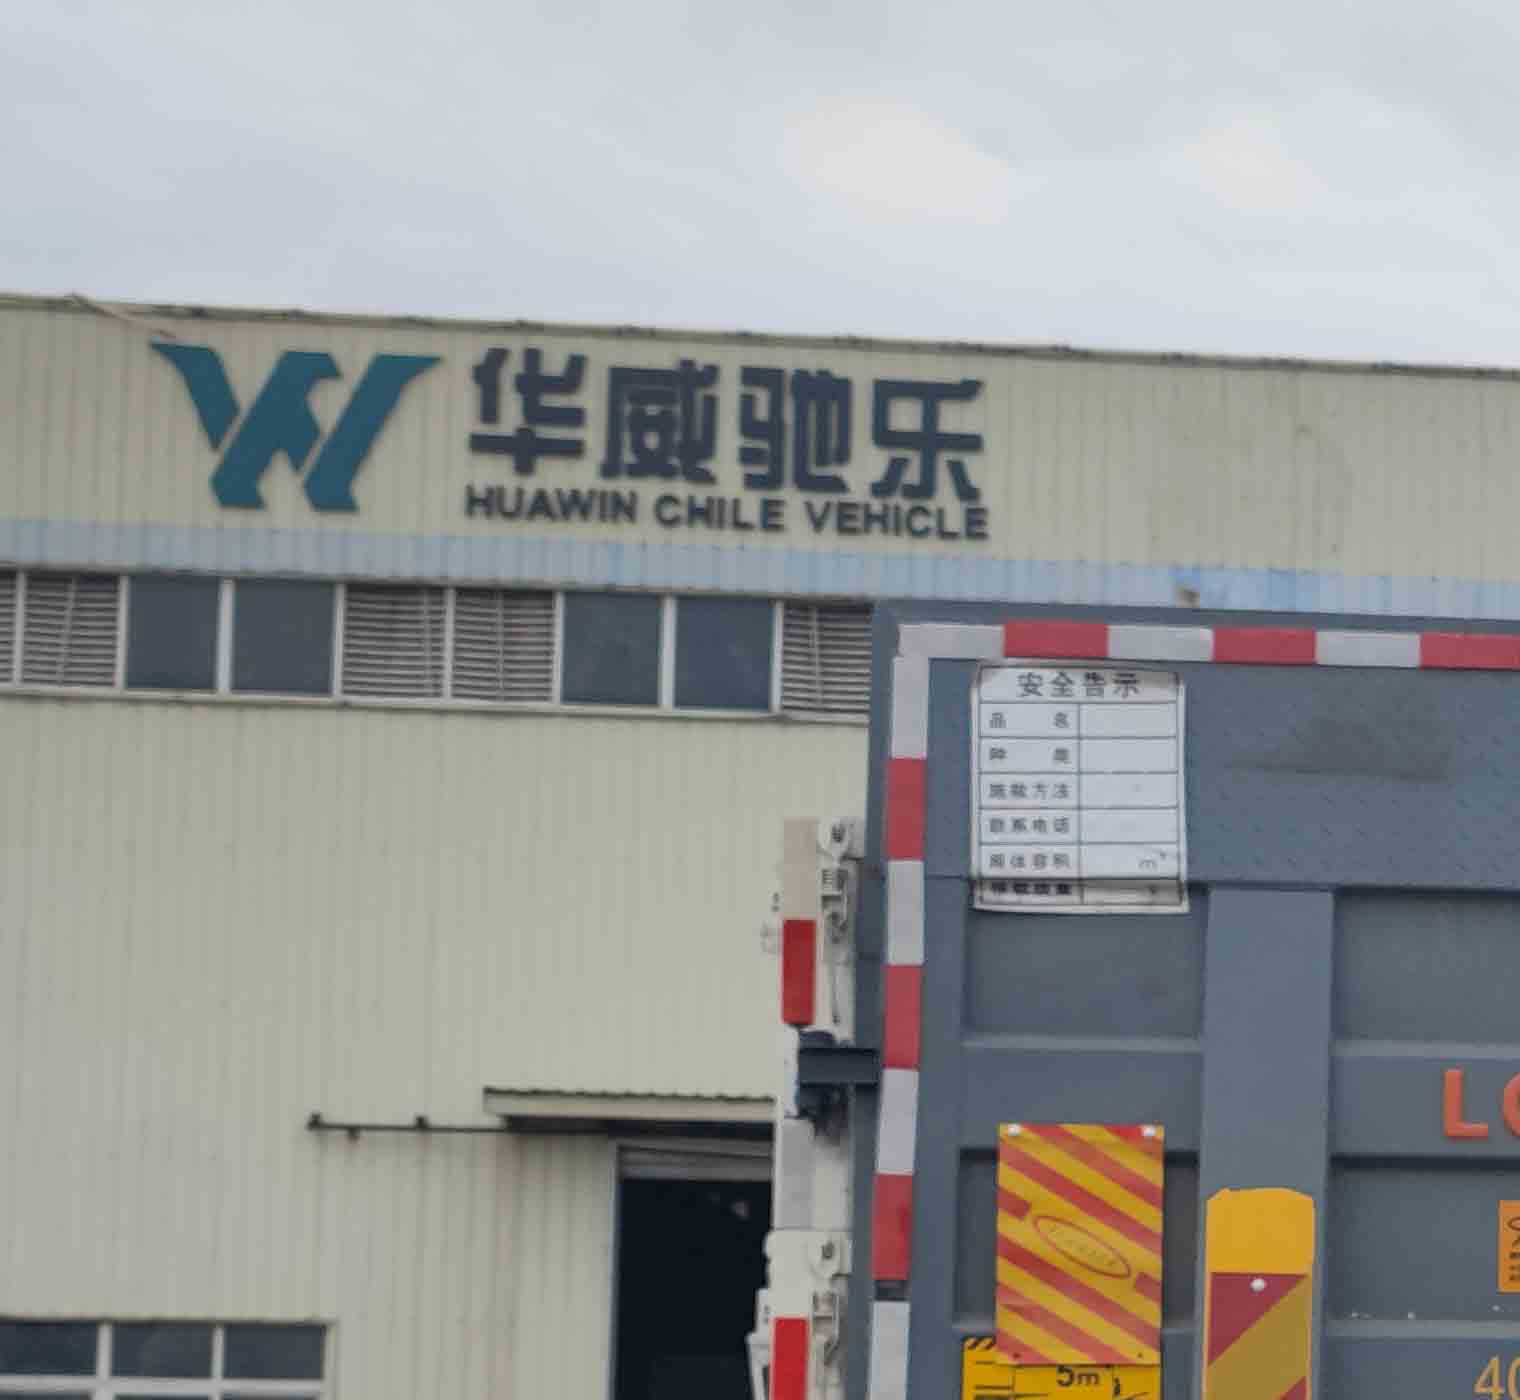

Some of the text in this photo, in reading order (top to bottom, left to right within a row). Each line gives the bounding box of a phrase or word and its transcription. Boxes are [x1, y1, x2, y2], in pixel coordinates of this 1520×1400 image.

[469, 347, 985, 503] 华威驰乐
[465, 484, 990, 541] HUAWIN CHILE VEHICLE
[1015, 671, 1140, 698] 安全告示
